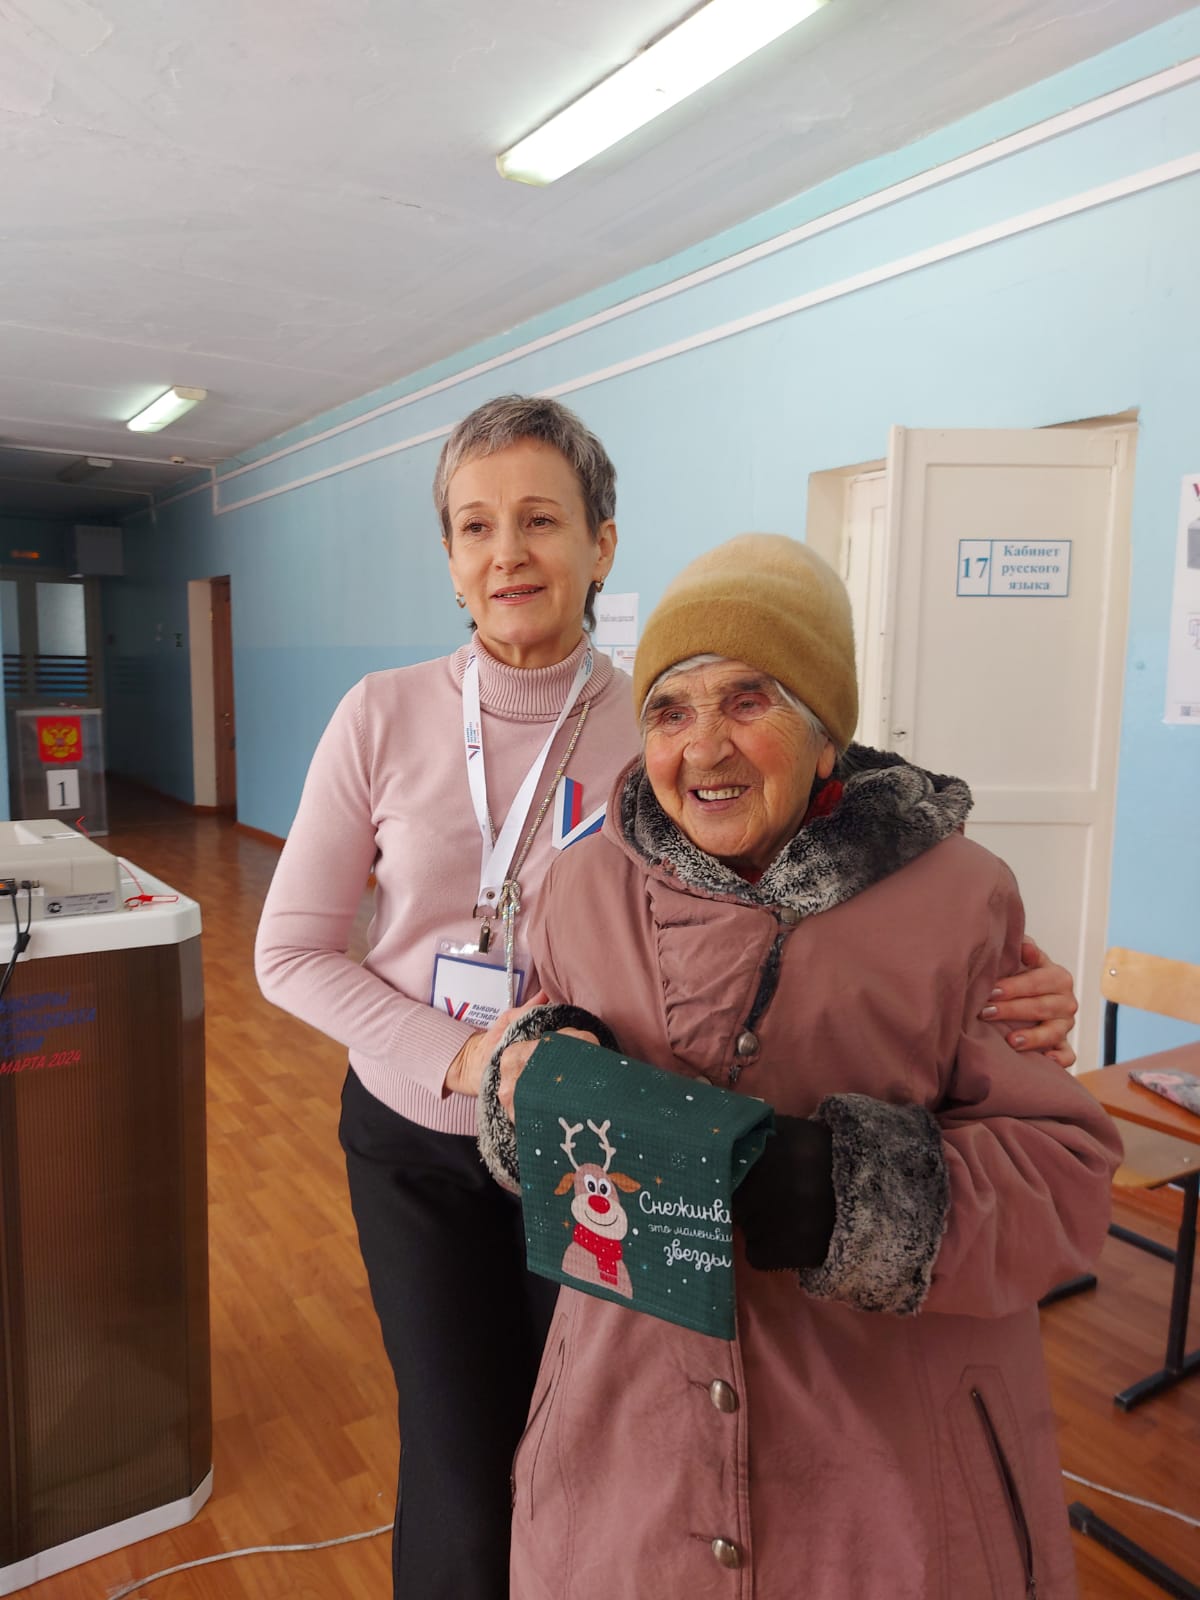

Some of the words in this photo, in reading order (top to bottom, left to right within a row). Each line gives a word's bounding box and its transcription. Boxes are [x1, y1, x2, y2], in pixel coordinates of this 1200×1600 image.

[1003, 545, 1060, 557] Кабинет
[962, 557, 989, 578] 17
[1001, 564, 1060, 576] русского
[1008, 581, 1050, 590] языка
[56, 781, 69, 806] 1
[47, 1050, 81, 1068] 2024
[648, 1224, 671, 1233] это
[663, 1238, 732, 1273] звезды
